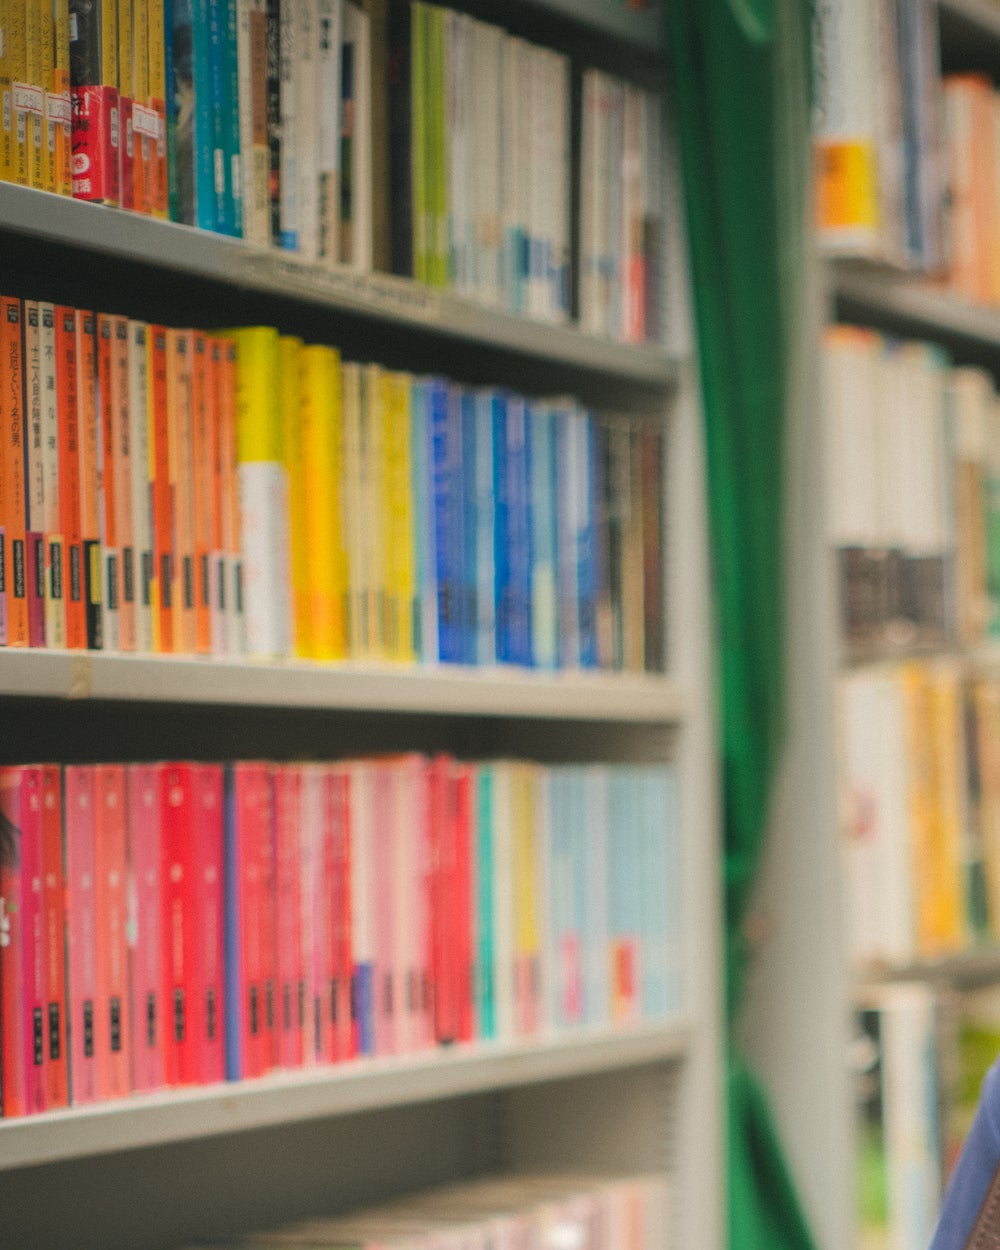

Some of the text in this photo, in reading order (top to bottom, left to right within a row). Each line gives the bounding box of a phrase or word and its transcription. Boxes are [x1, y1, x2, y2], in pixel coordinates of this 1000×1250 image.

[10, 341, 20, 448] 災厄という名の男
